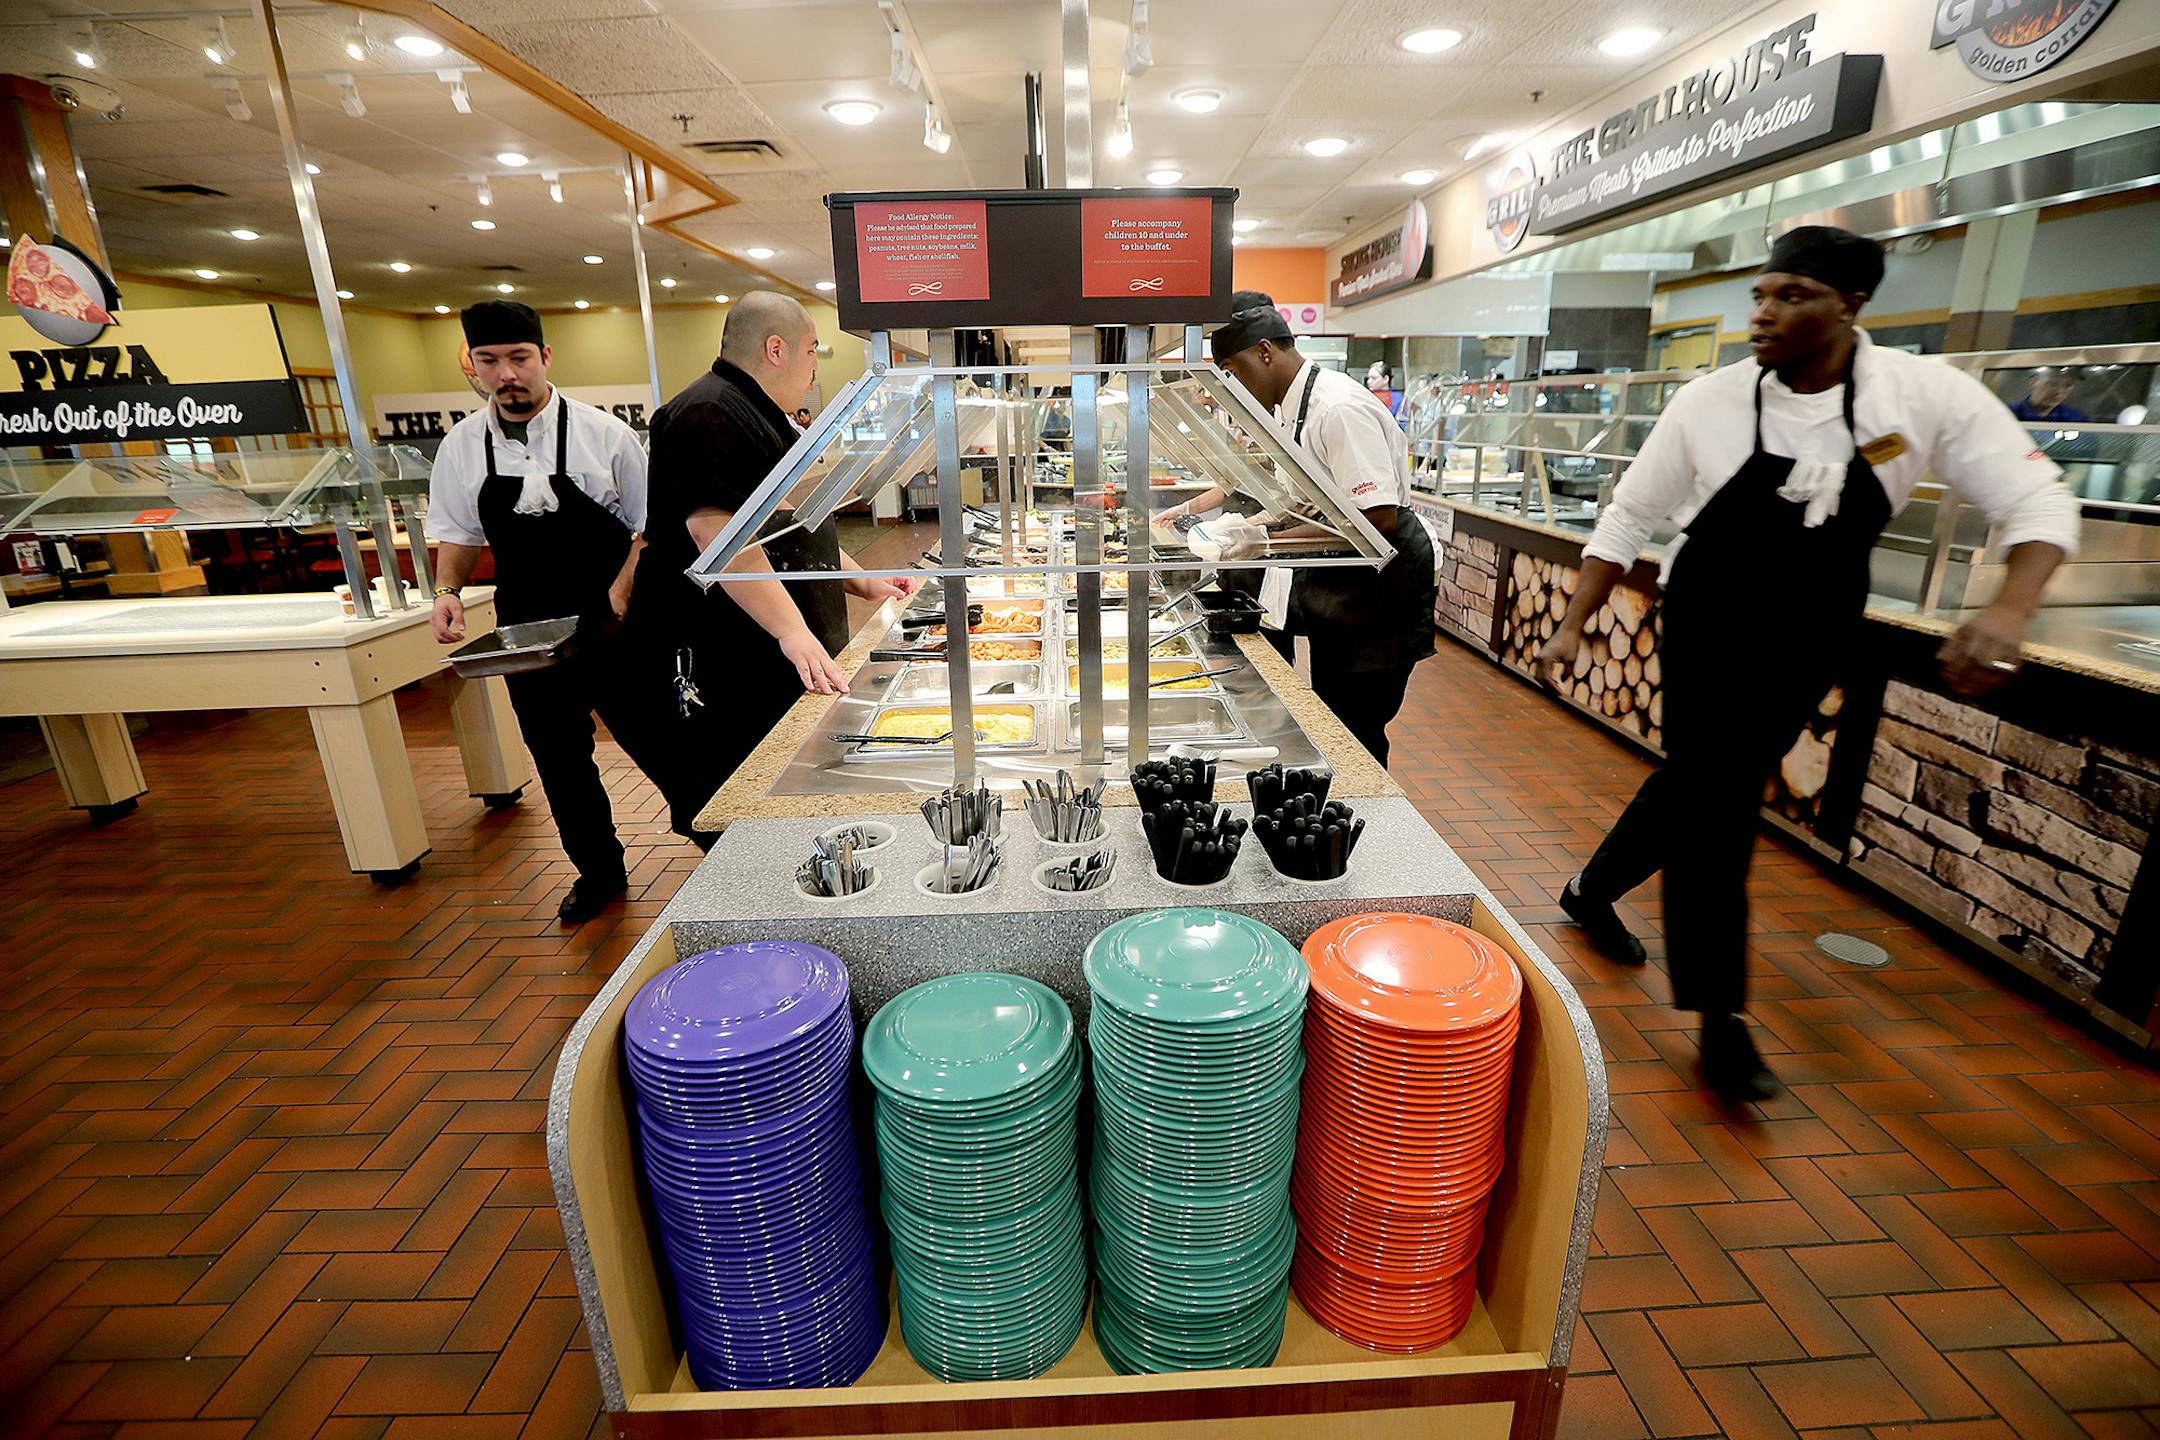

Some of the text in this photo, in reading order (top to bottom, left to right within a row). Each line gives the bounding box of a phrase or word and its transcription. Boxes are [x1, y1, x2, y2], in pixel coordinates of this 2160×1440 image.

[1968, 47, 2028, 74] golden
[1549, 12, 1817, 180] THE GRILLHOUSE
[1537, 92, 1816, 221] Premium Meats Grilled to Perfection
[888, 212, 954, 222] Food Allergy Notice:
[896, 223, 920, 231] advised
[948, 222, 976, 231] prepared
[1111, 219, 1182, 229] Please accompany
[1104, 230, 1189, 239] children 10 and under
[1121, 242, 1172, 251] to the buffet.
[9, 344, 169, 392] PIZZA
[0, 395, 243, 438] resh Out of the Oven
[384, 411, 447, 438] THE
